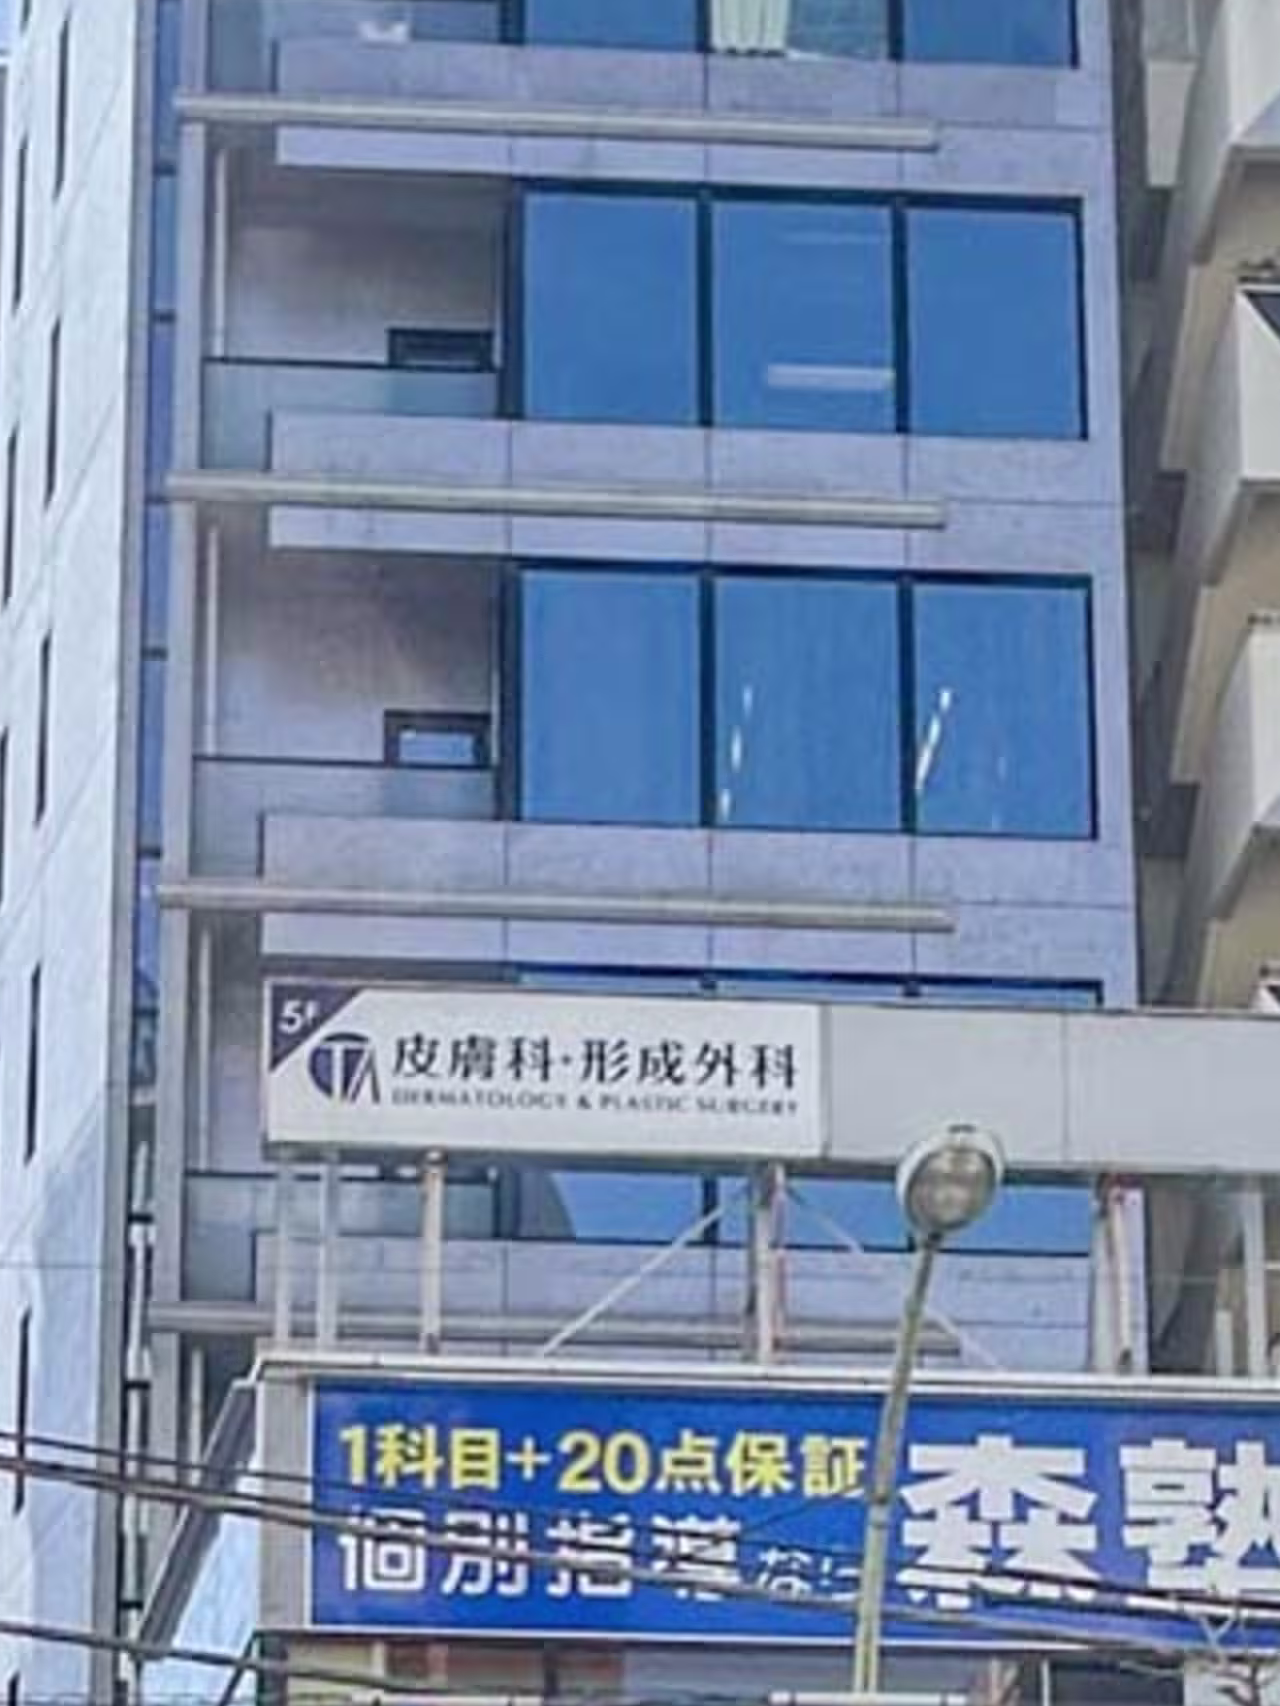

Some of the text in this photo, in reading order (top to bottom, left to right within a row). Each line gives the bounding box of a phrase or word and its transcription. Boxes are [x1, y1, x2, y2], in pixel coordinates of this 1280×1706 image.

[391, 1087, 567, 1111] DERMATOLOGY
[599, 1093, 686, 1112] PLASTIC
[696, 1095, 798, 1116] SURGERY
